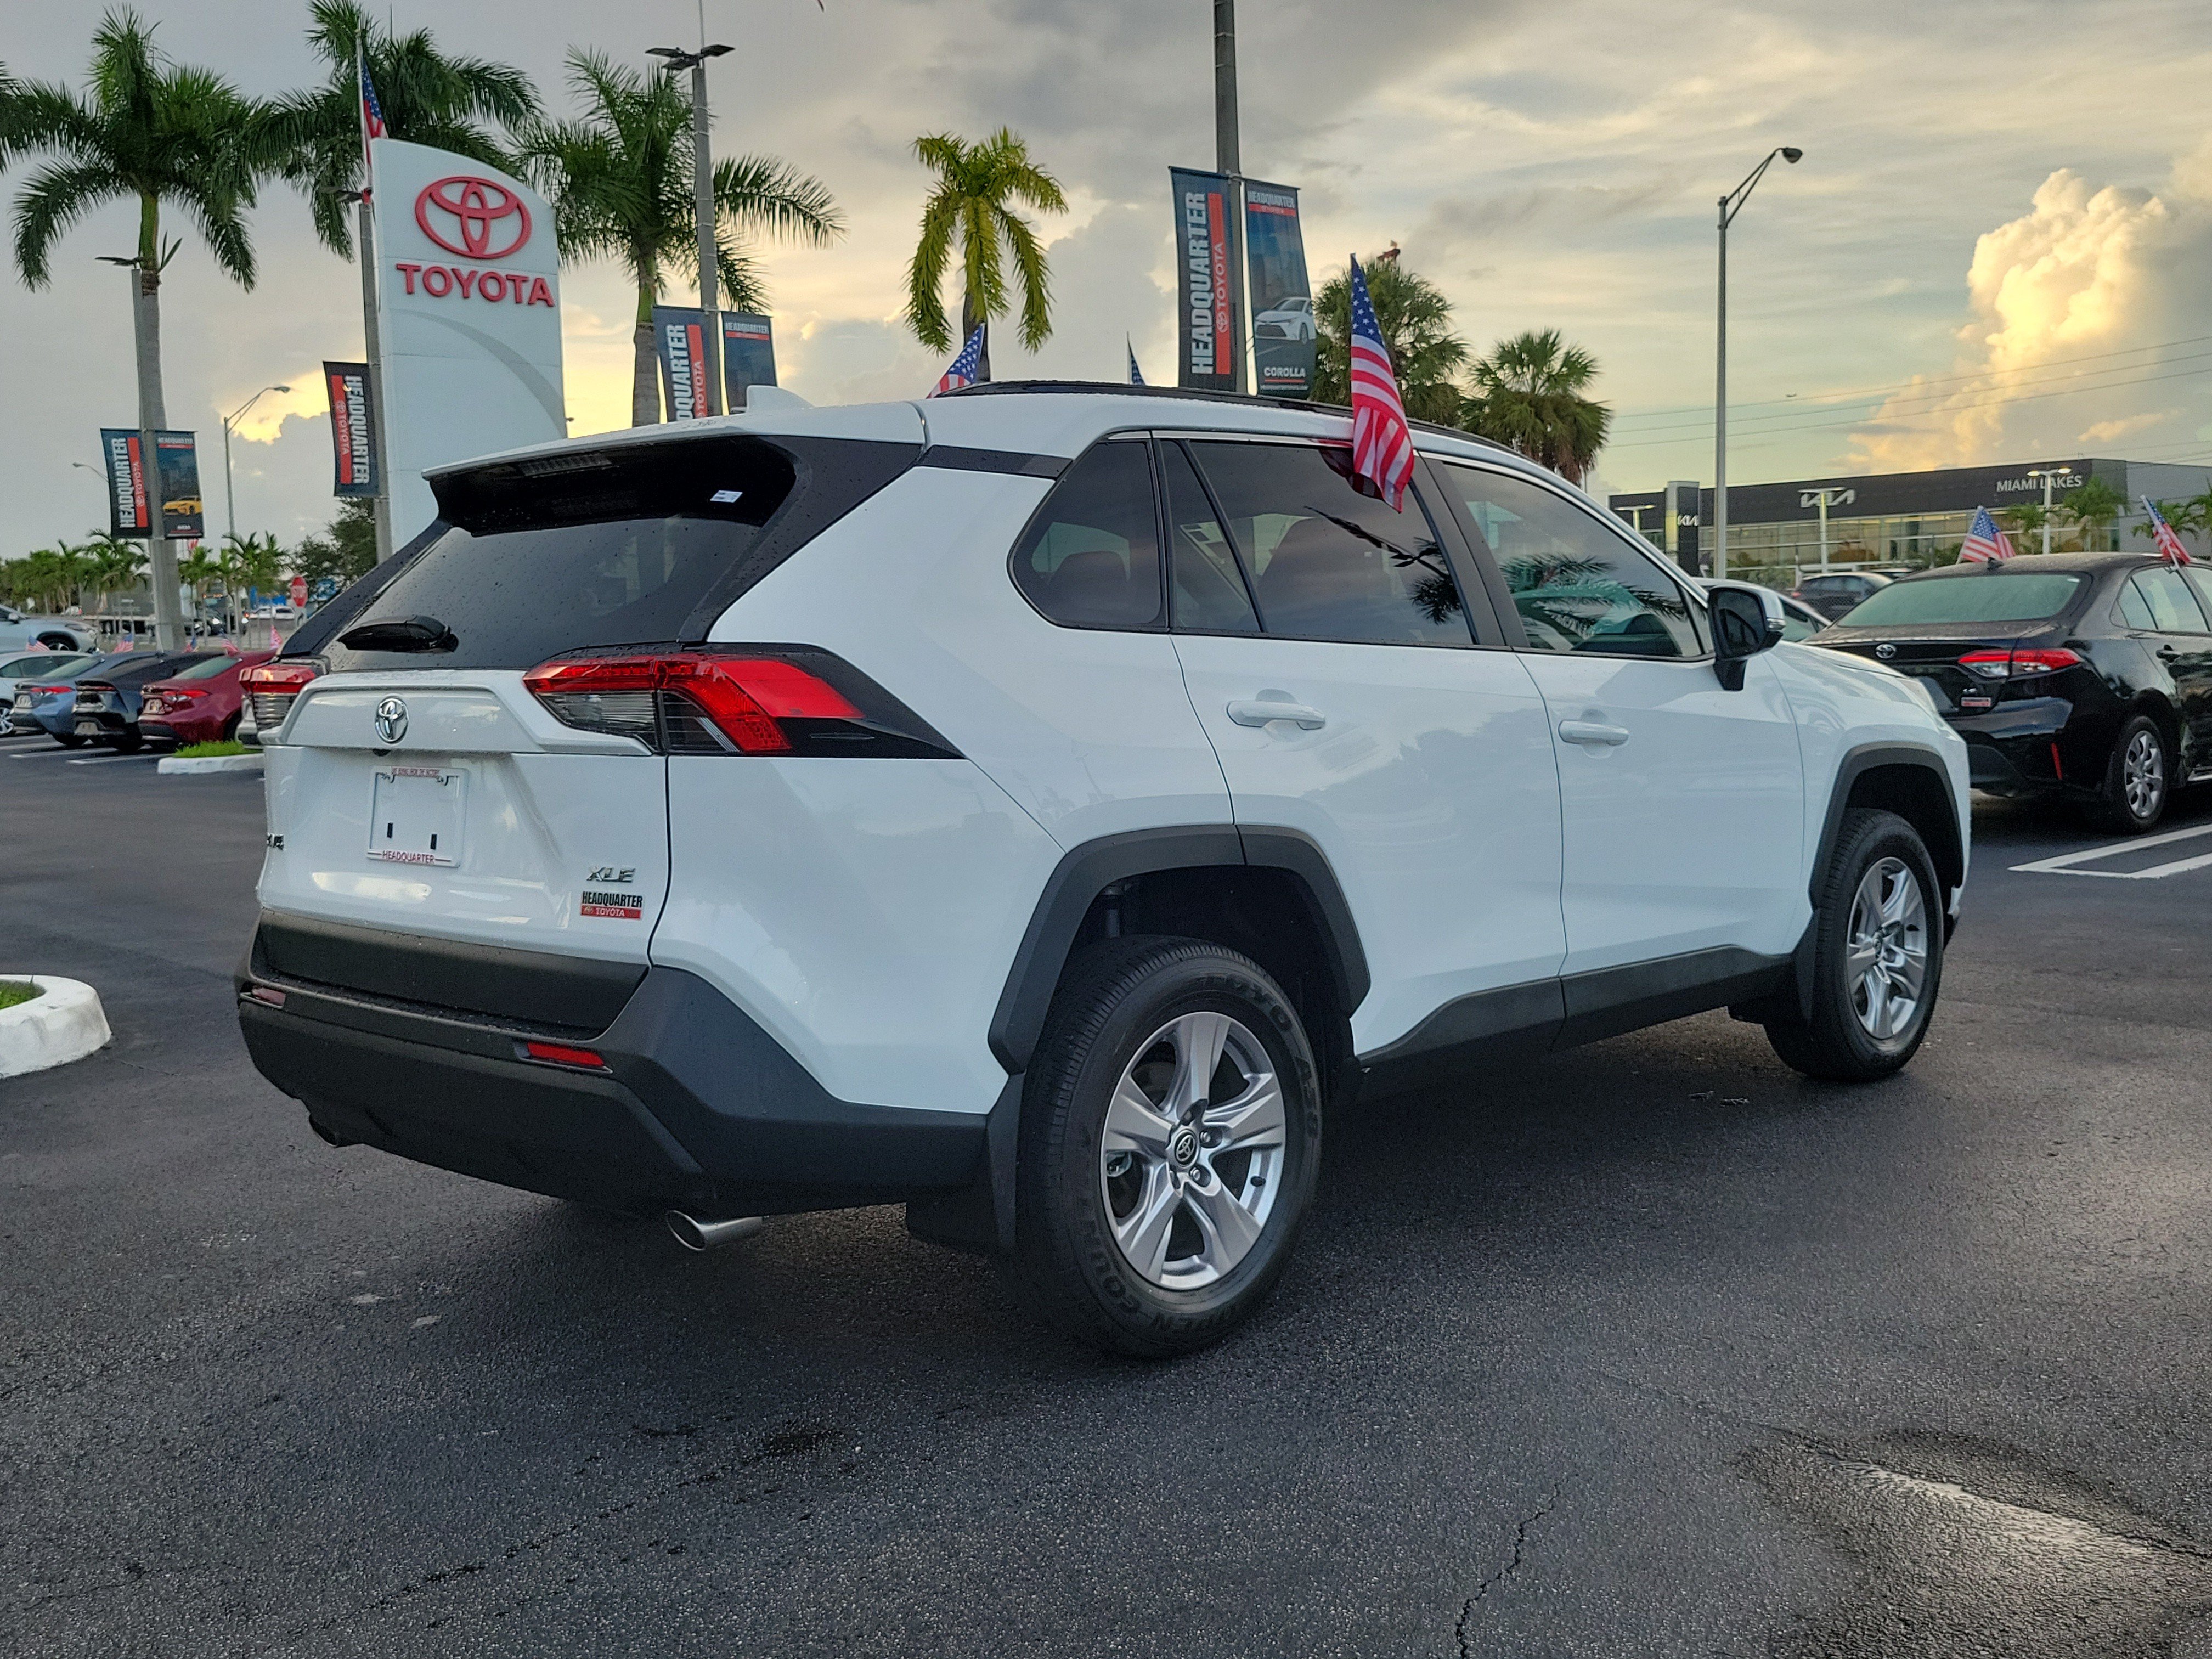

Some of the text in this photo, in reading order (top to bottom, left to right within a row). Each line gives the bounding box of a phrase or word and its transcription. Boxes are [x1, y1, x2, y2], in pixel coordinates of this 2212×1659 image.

[396, 263, 555, 307] TOYOTA
[1185, 191, 1214, 375] HEADQUARTER
[1212, 242, 1226, 312] TOYOTA
[692, 360, 707, 410] TOYOTA
[1263, 366, 1306, 377] COROLLA
[336, 413, 350, 455] TOYOTA
[344, 375, 370, 484] HEADQUARTER
[111, 437, 136, 528] HEADQUARTER
[1996, 475, 2083, 493] MIAMI LAKES
[1677, 515, 1700, 526] KIA
[382, 850, 436, 865] HEADQUARTER
[586, 866, 636, 883] XLE
[582, 890, 643, 908] HEADQUARTER
[595, 907, 625, 917] TOYOTA
